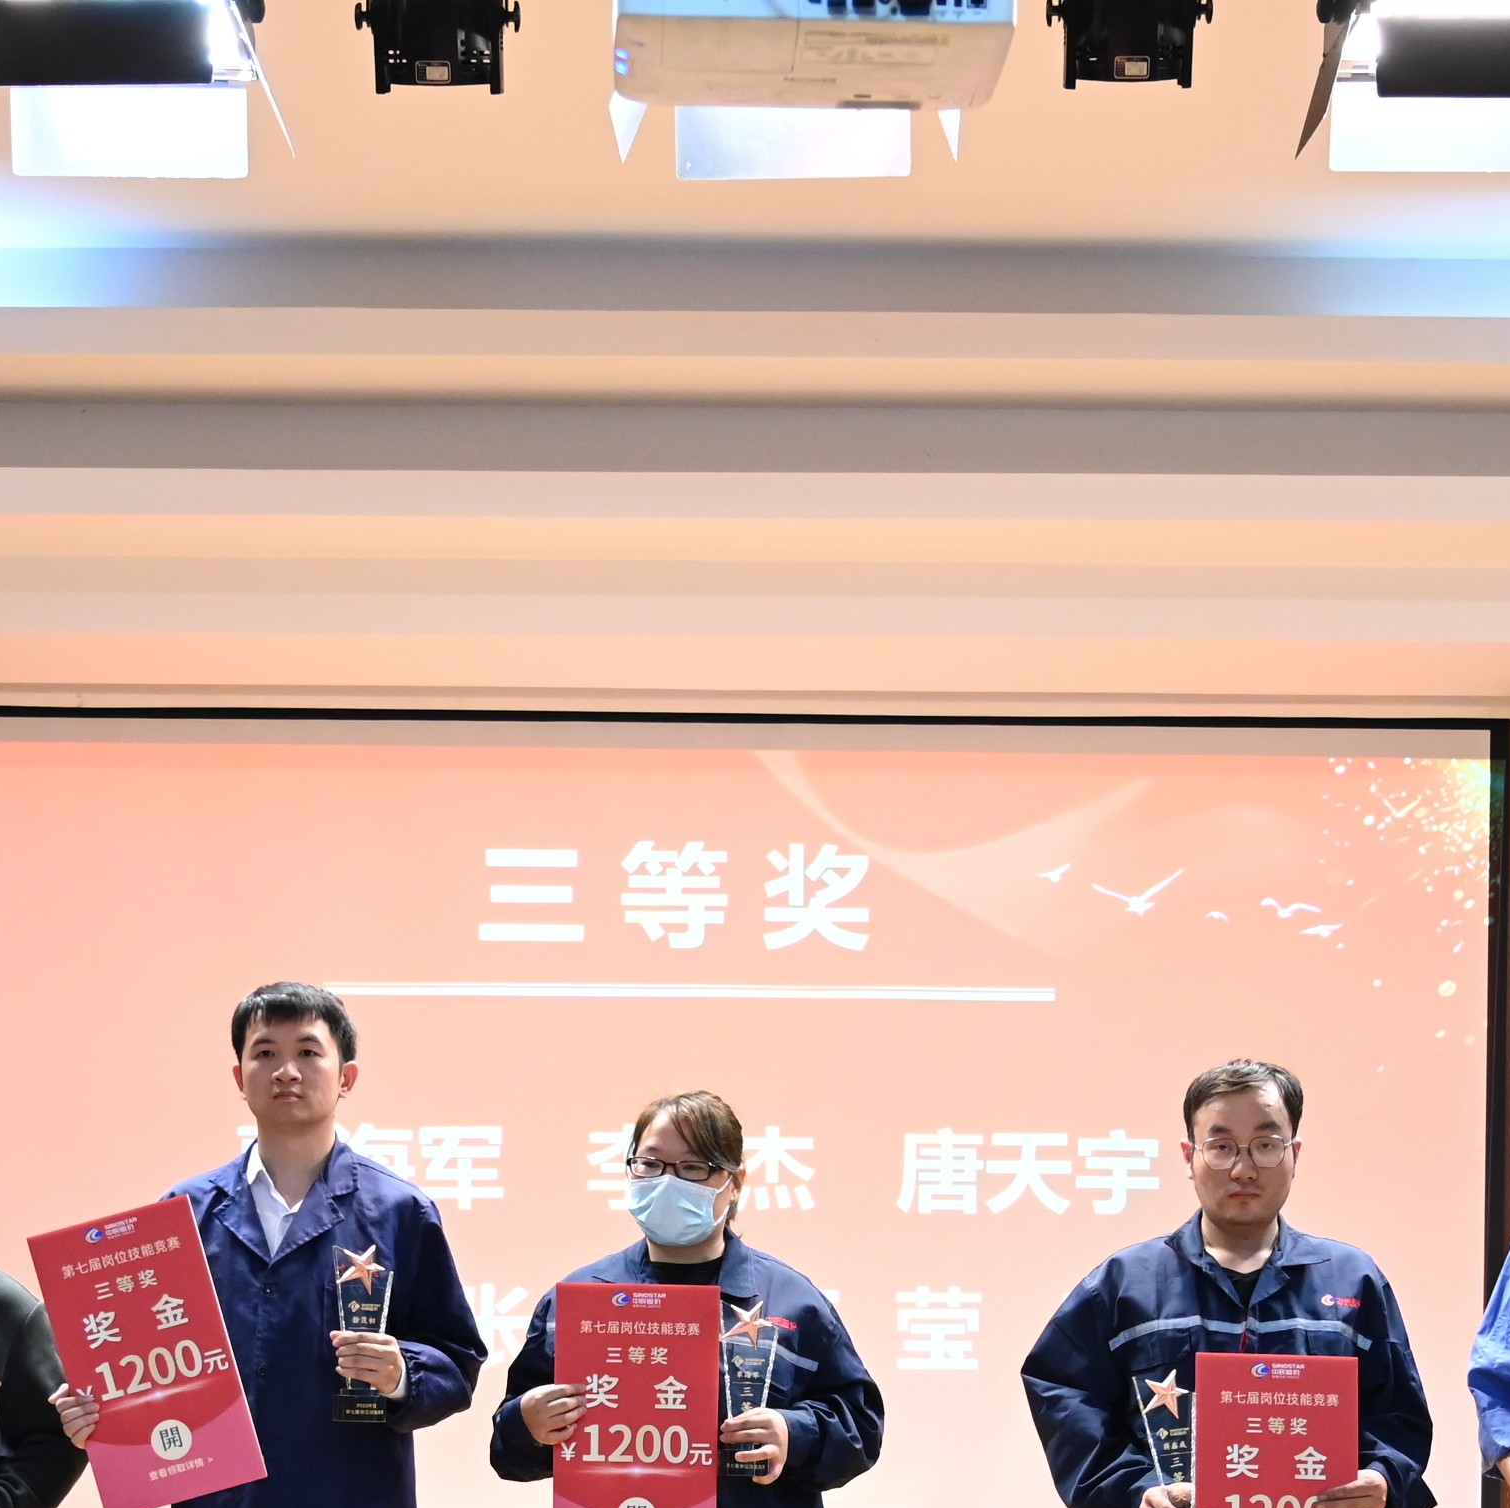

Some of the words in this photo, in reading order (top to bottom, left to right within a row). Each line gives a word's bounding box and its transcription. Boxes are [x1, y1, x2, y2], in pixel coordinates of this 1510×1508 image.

[478, 840, 870, 952] 三等奖
[237, 1124, 504, 1210] 海军
[896, 1127, 1160, 1215] 唐天宇
[61, 1237, 181, 1280] 第七届岗位技能竞赛
[94, 1269, 158, 1300] 三等奖
[82, 1293, 189, 1349] 奖金
[579, 1320, 700, 1337] 第七届岗位技能竞赛
[606, 1346, 668, 1365] 三等奖
[585, 1373, 688, 1410] 奖金
[1219, 1390, 1339, 1408] 第七届岗位技能竞赛
[161, 1424, 183, 1452] 開
[1245, 1417, 1308, 1436] 三等奖
[1225, 1443, 1328, 1481] 奖金
